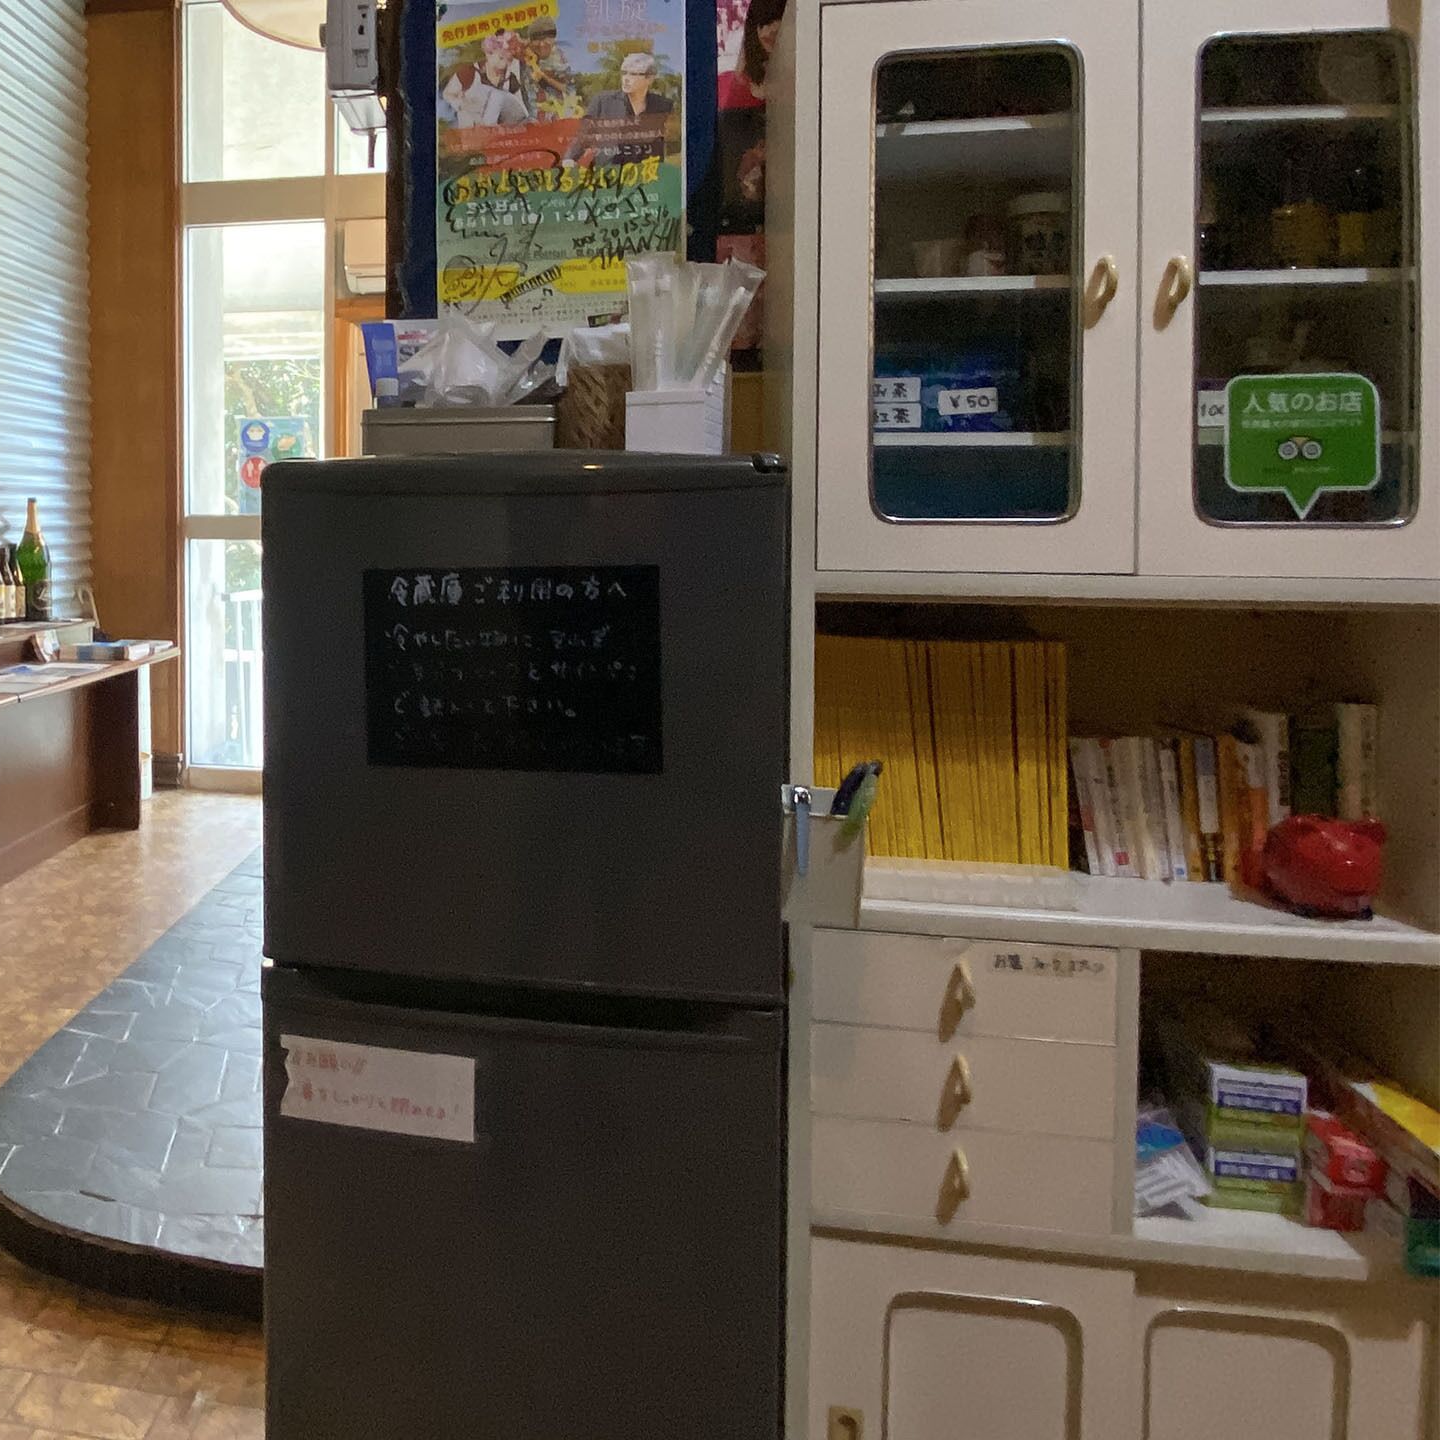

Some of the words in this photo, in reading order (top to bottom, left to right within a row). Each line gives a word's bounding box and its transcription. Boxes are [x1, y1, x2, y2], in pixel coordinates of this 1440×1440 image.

[1241, 390, 1364, 414] 人気のお店
